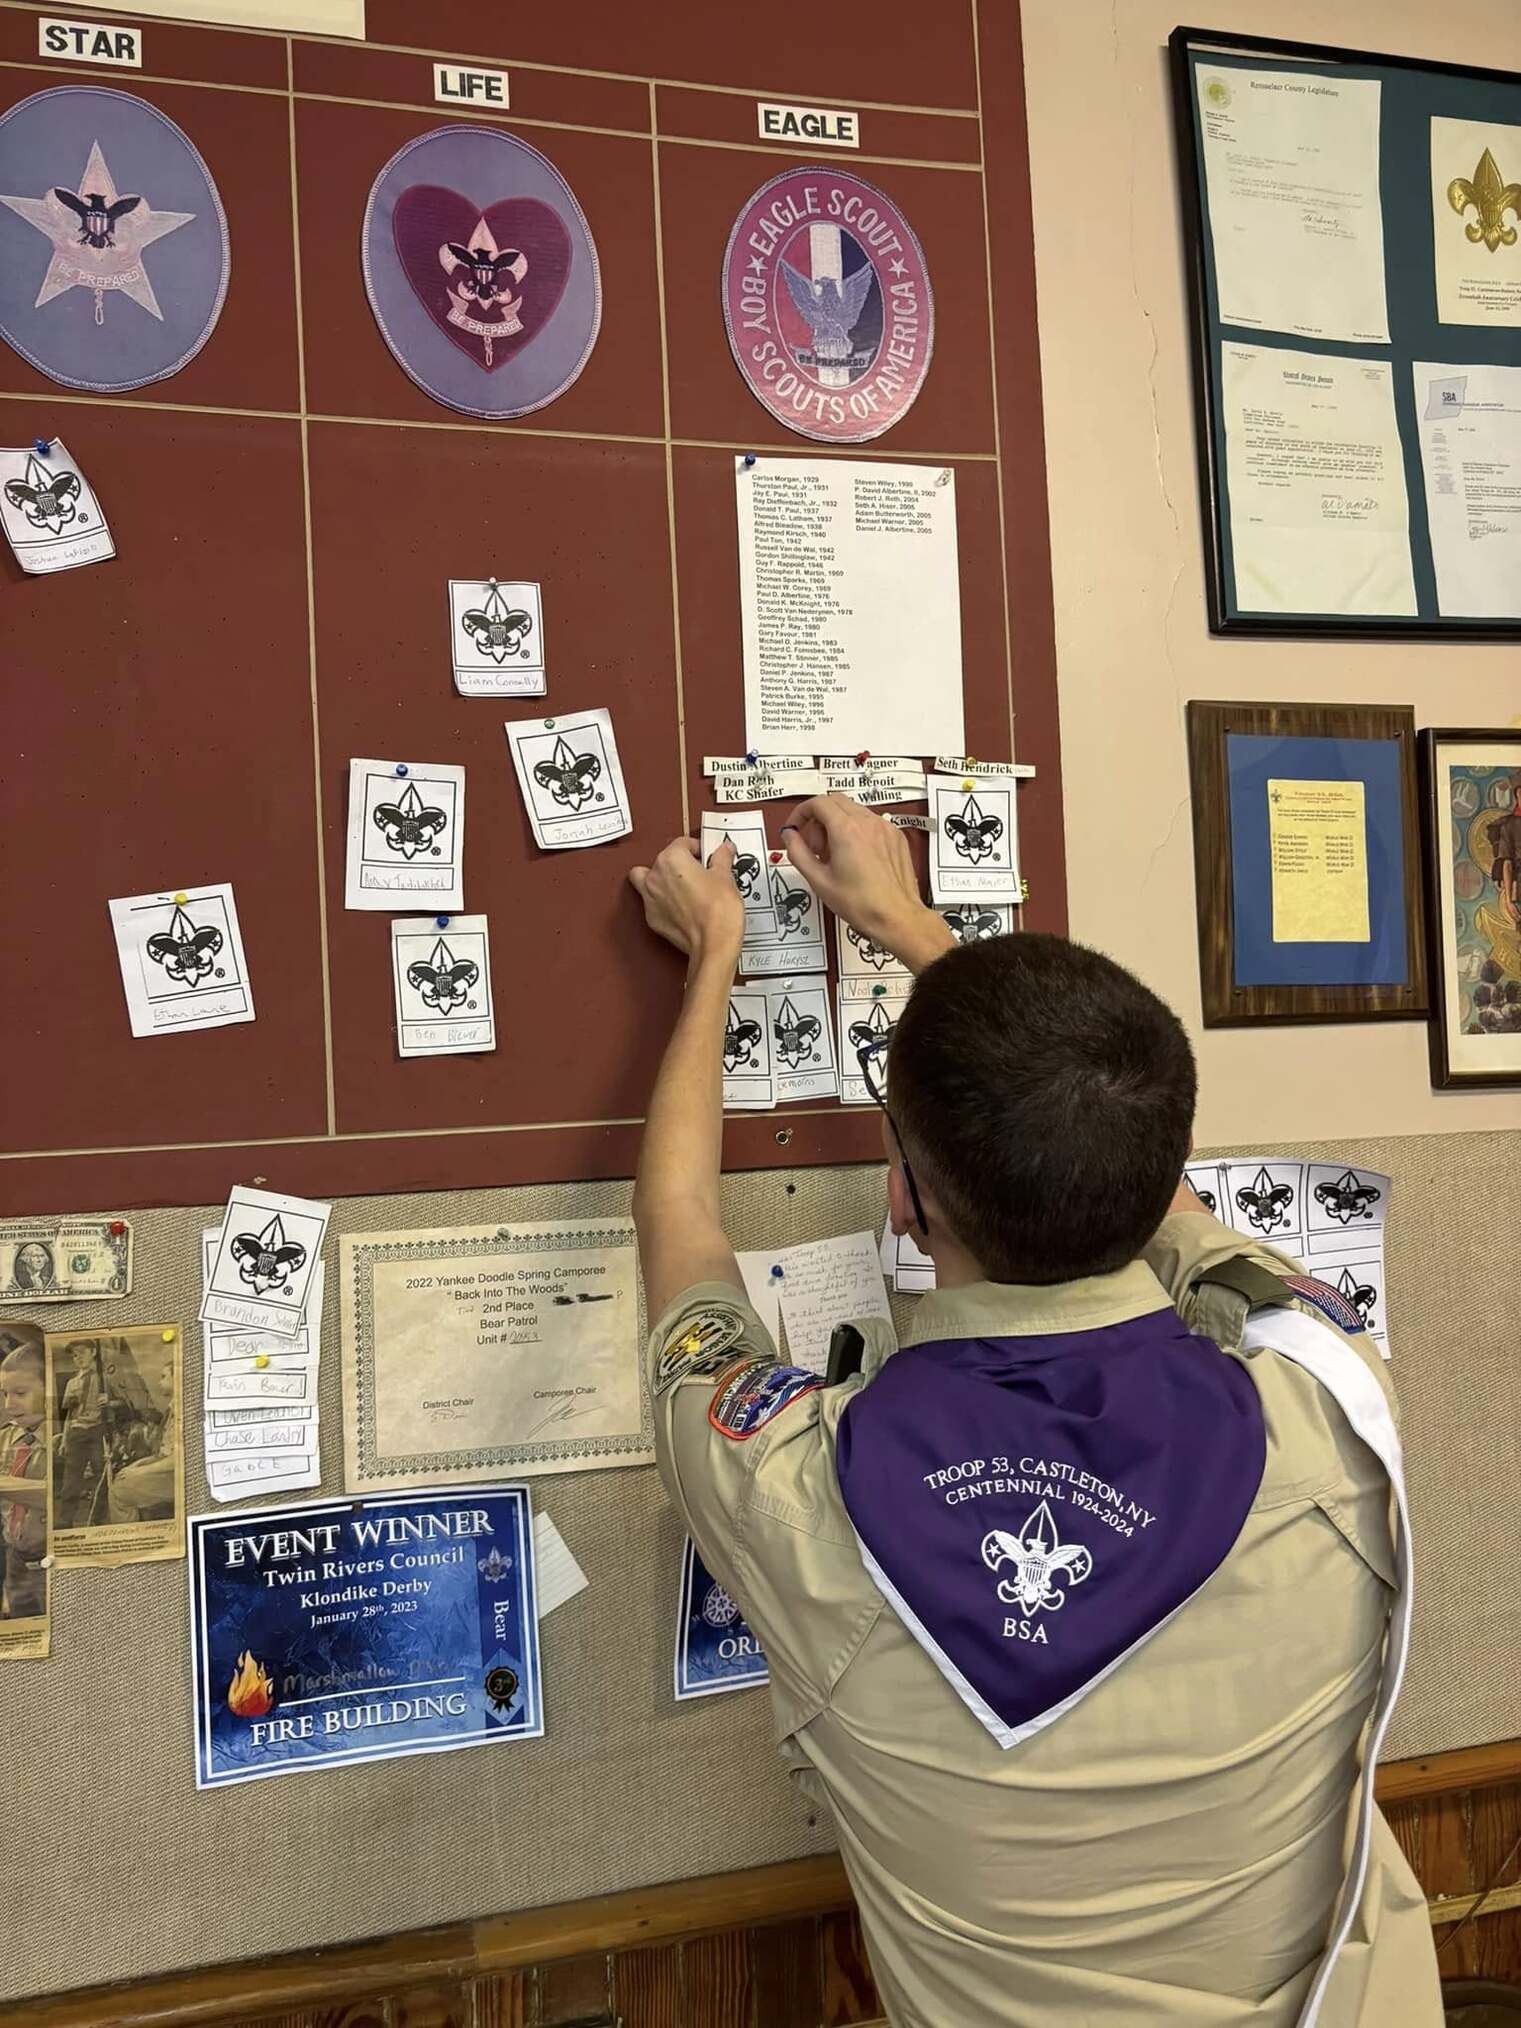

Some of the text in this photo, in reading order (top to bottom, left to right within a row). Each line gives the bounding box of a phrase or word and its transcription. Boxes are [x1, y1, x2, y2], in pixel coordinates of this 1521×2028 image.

[45, 25, 136, 60] STAR
[440, 70, 503, 102] LIFE
[1284, 84, 1306, 94] County
[763, 109, 854, 141] EAGLE
[748, 187, 904, 257] EAGLE SCOUT
[740, 275, 920, 425] BOY SCOUTS OF AMERICA
[1442, 391, 1457, 402] SBA
[459, 672, 494, 685] Liam
[712, 761, 747, 772] Dustin
[823, 758, 851, 769] Brett
[937, 757, 1013, 774] Seth Hendrick
[723, 776, 744, 788] Dan
[827, 775, 895, 788] Tadd Benoit
[725, 787, 784, 801] KC Shafer
[890, 816, 927, 828] Knight
[406, 1266, 606, 1289] 2022 Yankee Doodle Spring Camporee
[483, 1289, 504, 1298] Into
[506, 1286, 526, 1297] The
[214, 1299, 270, 1327] Brandon
[483, 1303, 504, 1314] 2nd
[505, 1301, 535, 1312] Place
[480, 1315, 538, 1330] Bear Patrol
[476, 1334, 498, 1345] Unit
[500, 1333, 508, 1344] #
[533, 1386, 598, 1401] Camporee Chair
[422, 1398, 475, 1410] District Chair
[214, 1431, 256, 1448] Chase
[923, 1457, 1156, 1529] TROOP 53, CASTLETON, NY
[945, 1478, 1134, 1538] CENTENNIAL 1924-2024
[224, 1510, 495, 1568] EVENT WINNER
[263, 1546, 465, 1589] Twin Rivers Council
[301, 1578, 433, 1609] Klondike Derby
[310, 1600, 418, 1629] January 28th, 2023
[492, 1599, 510, 1642] Bear
[1001, 1616, 1049, 1645] BSA
[283, 1663, 399, 1695] Marshmallow
[250, 1692, 468, 1748] FIRE BUILDING
